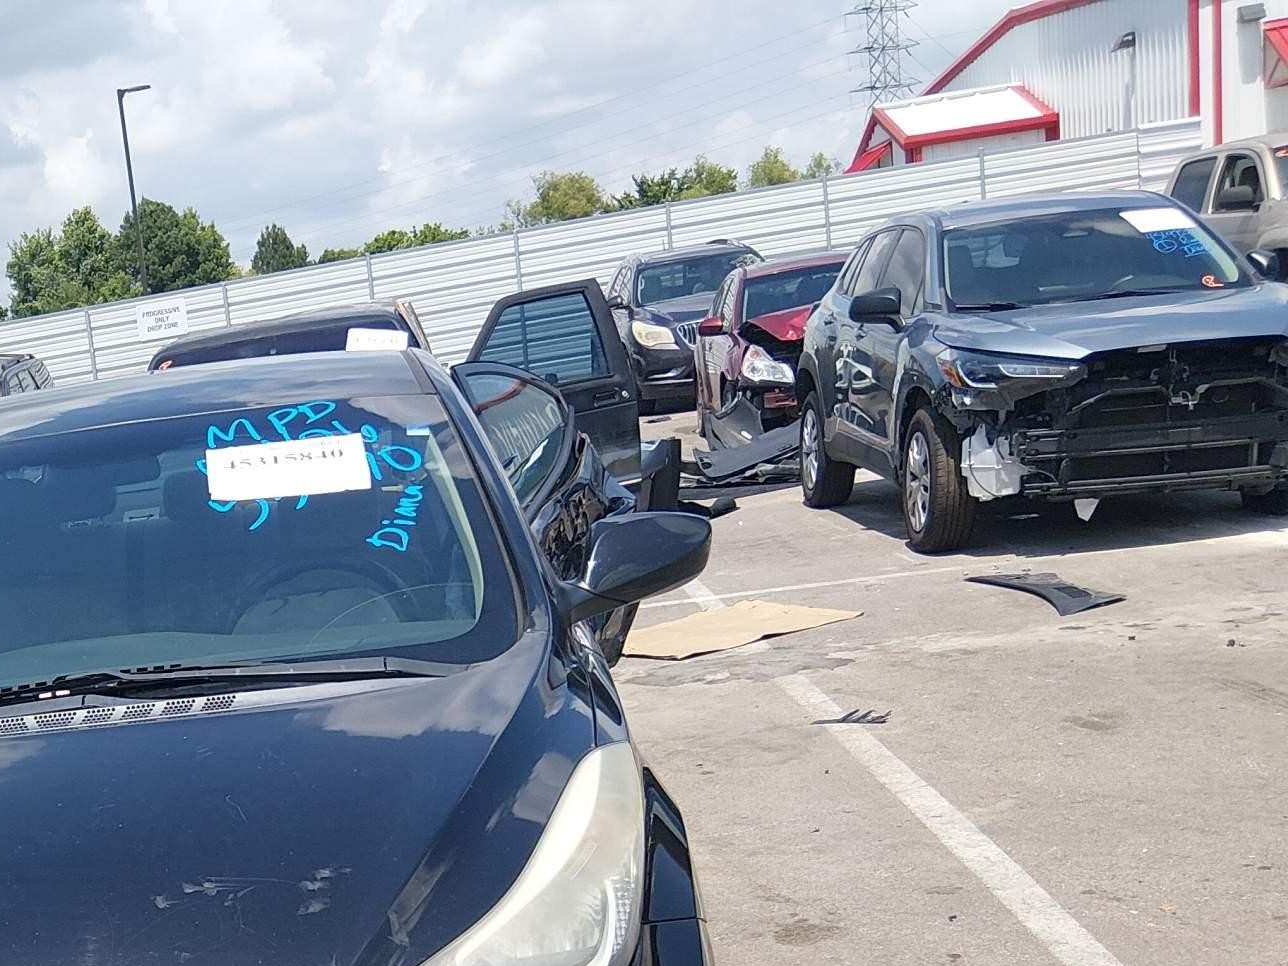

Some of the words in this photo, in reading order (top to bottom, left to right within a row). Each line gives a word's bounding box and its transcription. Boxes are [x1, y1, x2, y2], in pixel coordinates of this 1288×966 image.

[142, 306, 181, 318] PROGRESSIVE
[154, 315, 170, 324] ONLY
[147, 324, 163, 332] DROP
[163, 321, 179, 330] ZONE
